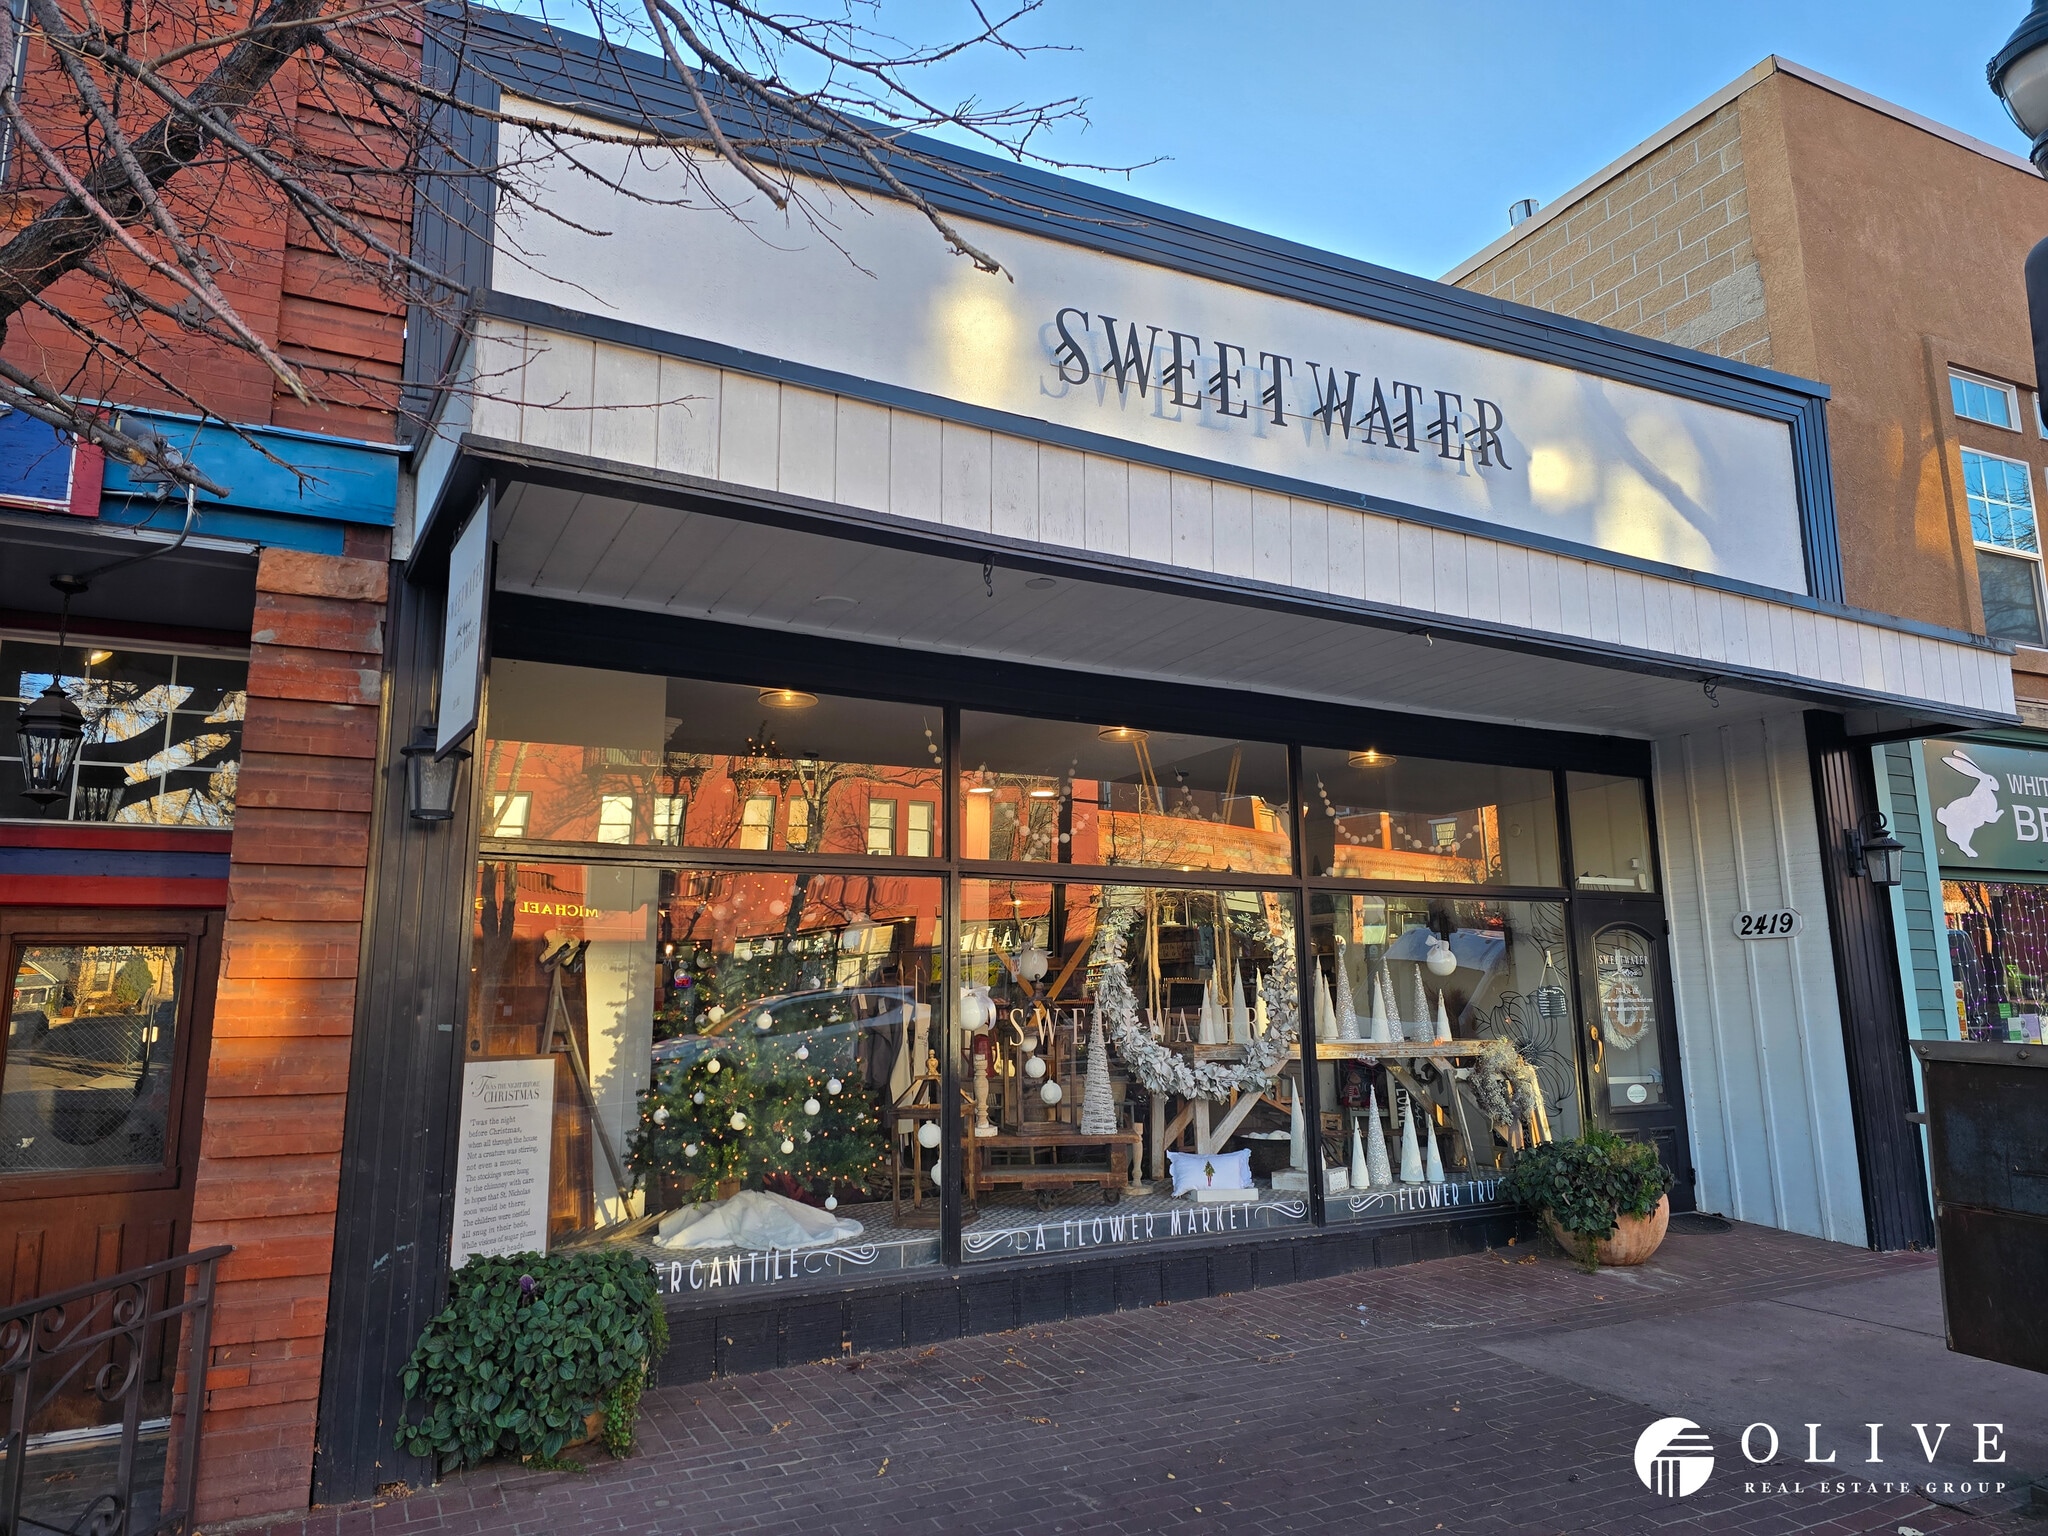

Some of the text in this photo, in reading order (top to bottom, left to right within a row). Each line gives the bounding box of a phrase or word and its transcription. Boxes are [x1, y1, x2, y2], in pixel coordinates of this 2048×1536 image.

[1054, 307, 1512, 470] SWEETWATER
[1740, 913, 1794, 935] 2419
[1009, 1007, 1261, 1047] SWEETWATER
[484, 1089, 540, 1103] CHRISTMAS
[489, 1117, 500, 1125] the
[501, 1116, 516, 1126] night
[469, 1130, 487, 1138] before
[492, 1137, 513, 1146] through
[514, 1136, 522, 1144] the
[523, 1135, 538, 1143] house
[467, 1152, 478, 1160] Not
[483, 1150, 505, 1158] creature
[477, 1171, 502, 1181] stockings
[465, 1187, 472, 1195] by
[484, 1182, 508, 1191] chimney
[1400, 1177, 1504, 1212] FLOWER TRU
[464, 1197, 470, 1205] In
[471, 1195, 486, 1205] hopes
[488, 1192, 499, 1200] that
[508, 1188, 531, 1197] Nicholas
[479, 1204, 497, 1212] would
[475, 1216, 496, 1225] children
[512, 1208, 530, 1217] nestled
[462, 1231, 471, 1239] all
[472, 1229, 487, 1237] snug
[497, 1224, 512, 1232] their
[1035, 1203, 1251, 1251] A FLOWER MARKET
[461, 1230, 536, 1249] While visions of sugar plums
[491, 1246, 505, 1255] their
[655, 1249, 798, 1294] ERCANTILE
